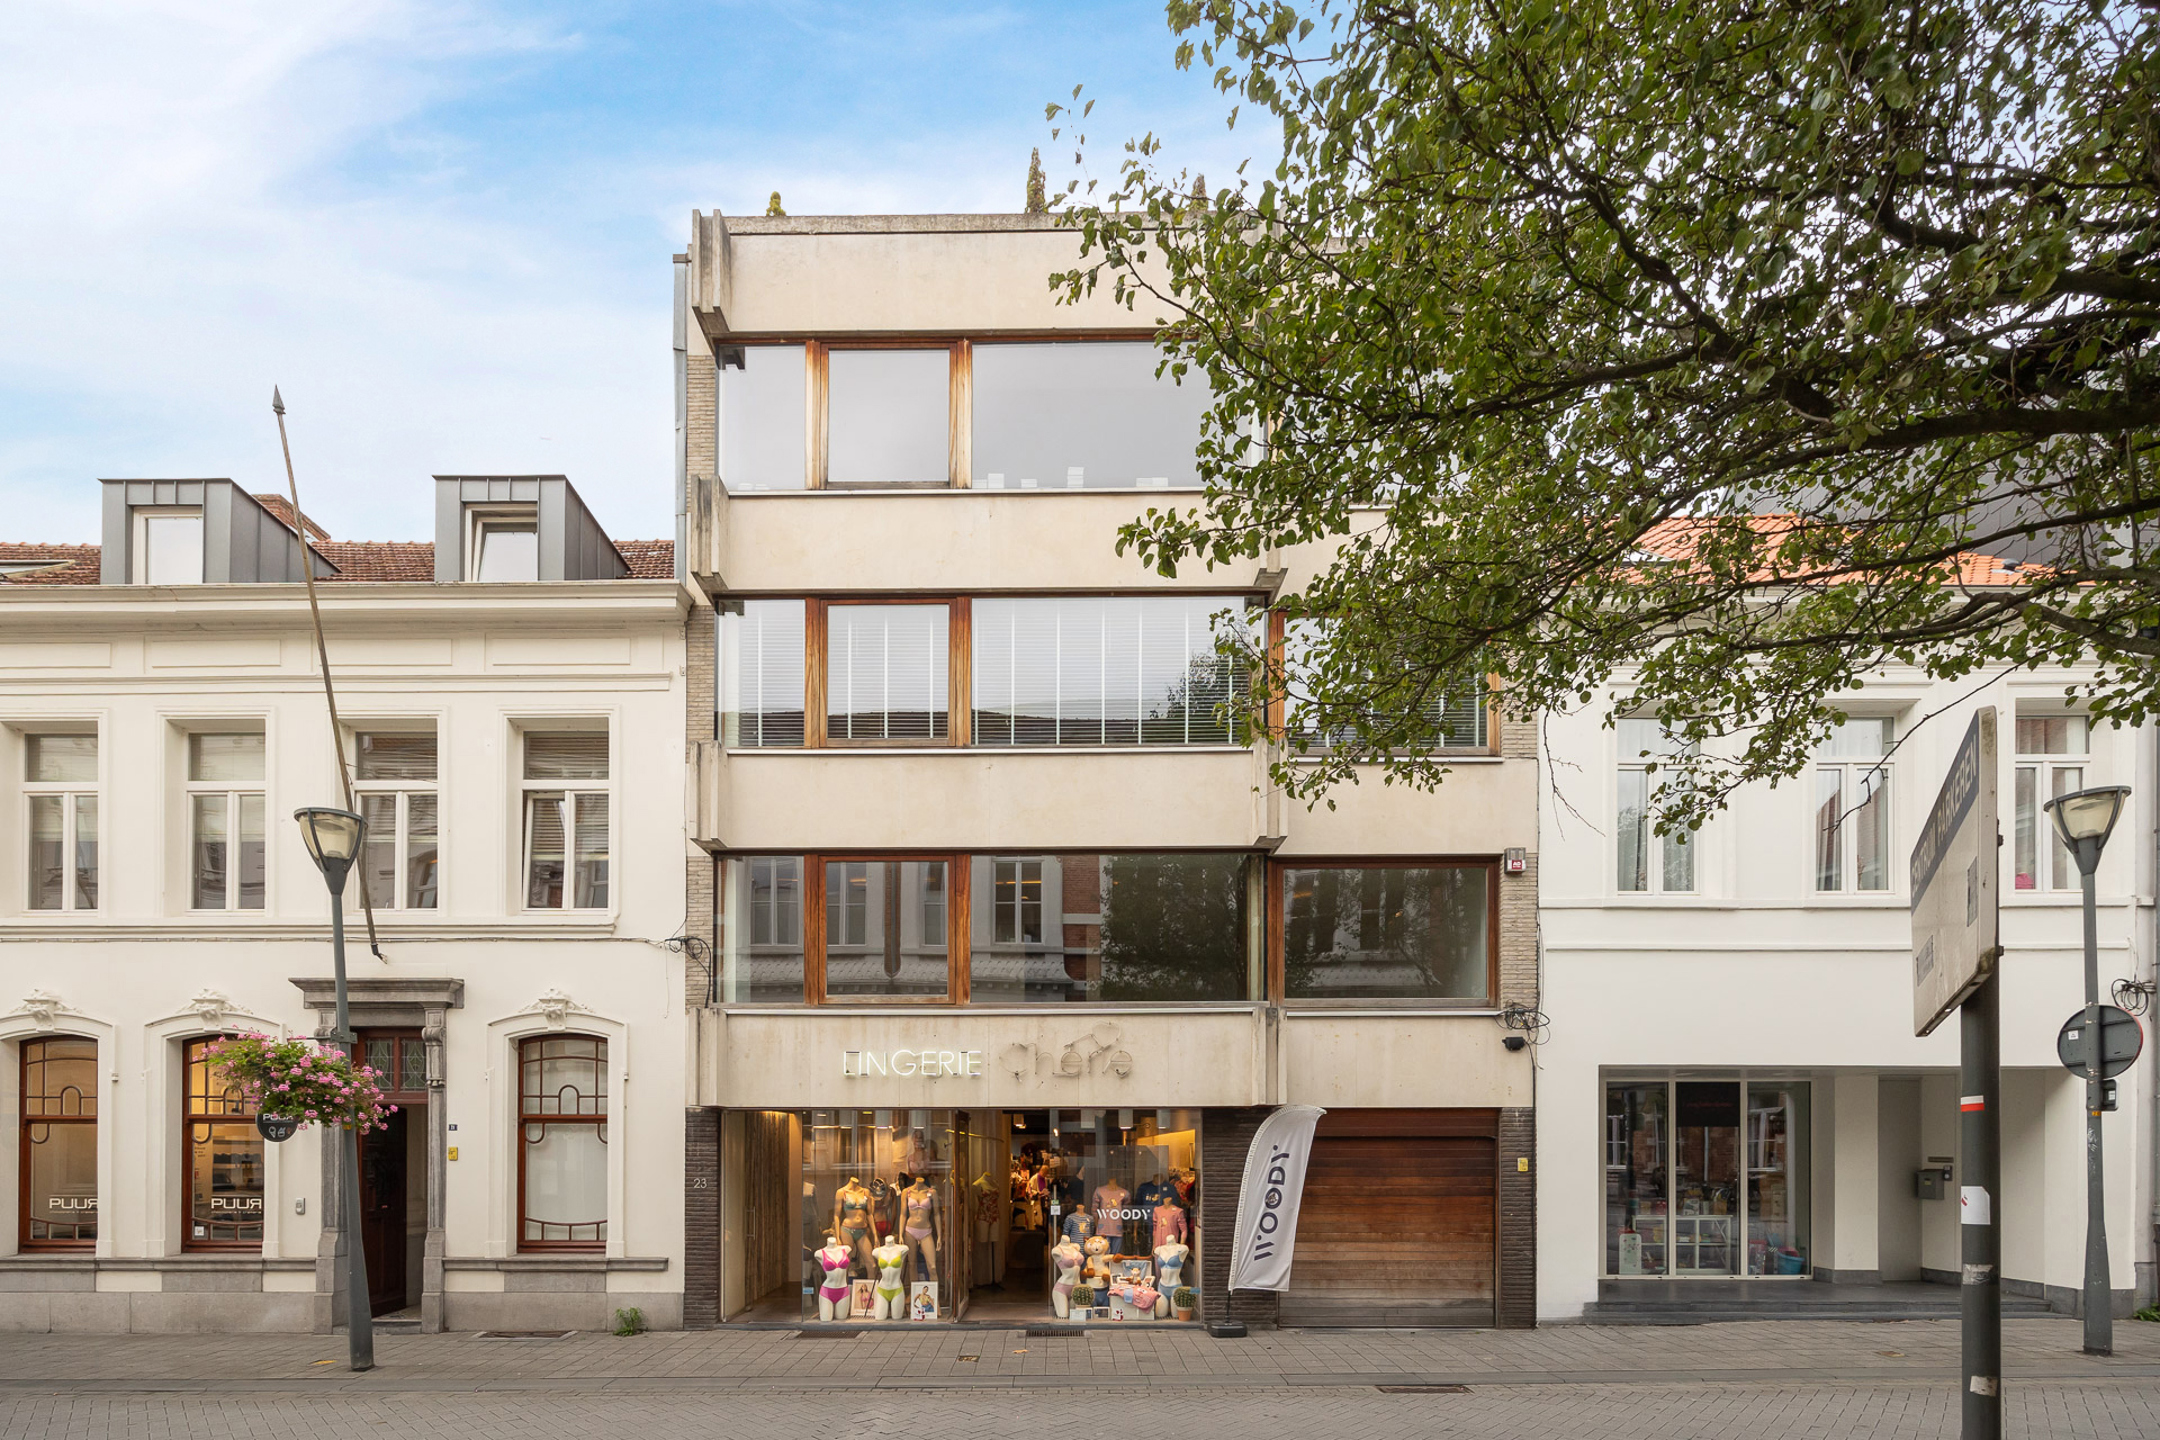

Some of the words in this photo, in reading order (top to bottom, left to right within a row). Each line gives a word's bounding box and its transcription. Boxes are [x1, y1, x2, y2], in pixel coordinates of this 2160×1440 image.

[1911, 822, 1937, 899] CENTRUM
[1937, 733, 1977, 847] PARKEREN
[843, 1050, 982, 1077] LINGERIE
[693, 1177, 708, 1189] 23
[48, 1197, 98, 1209] PUUR
[211, 1197, 262, 1209] PUUR
[1253, 1144, 1290, 1262] WOODY
[1096, 1208, 1151, 1220] WOODY
